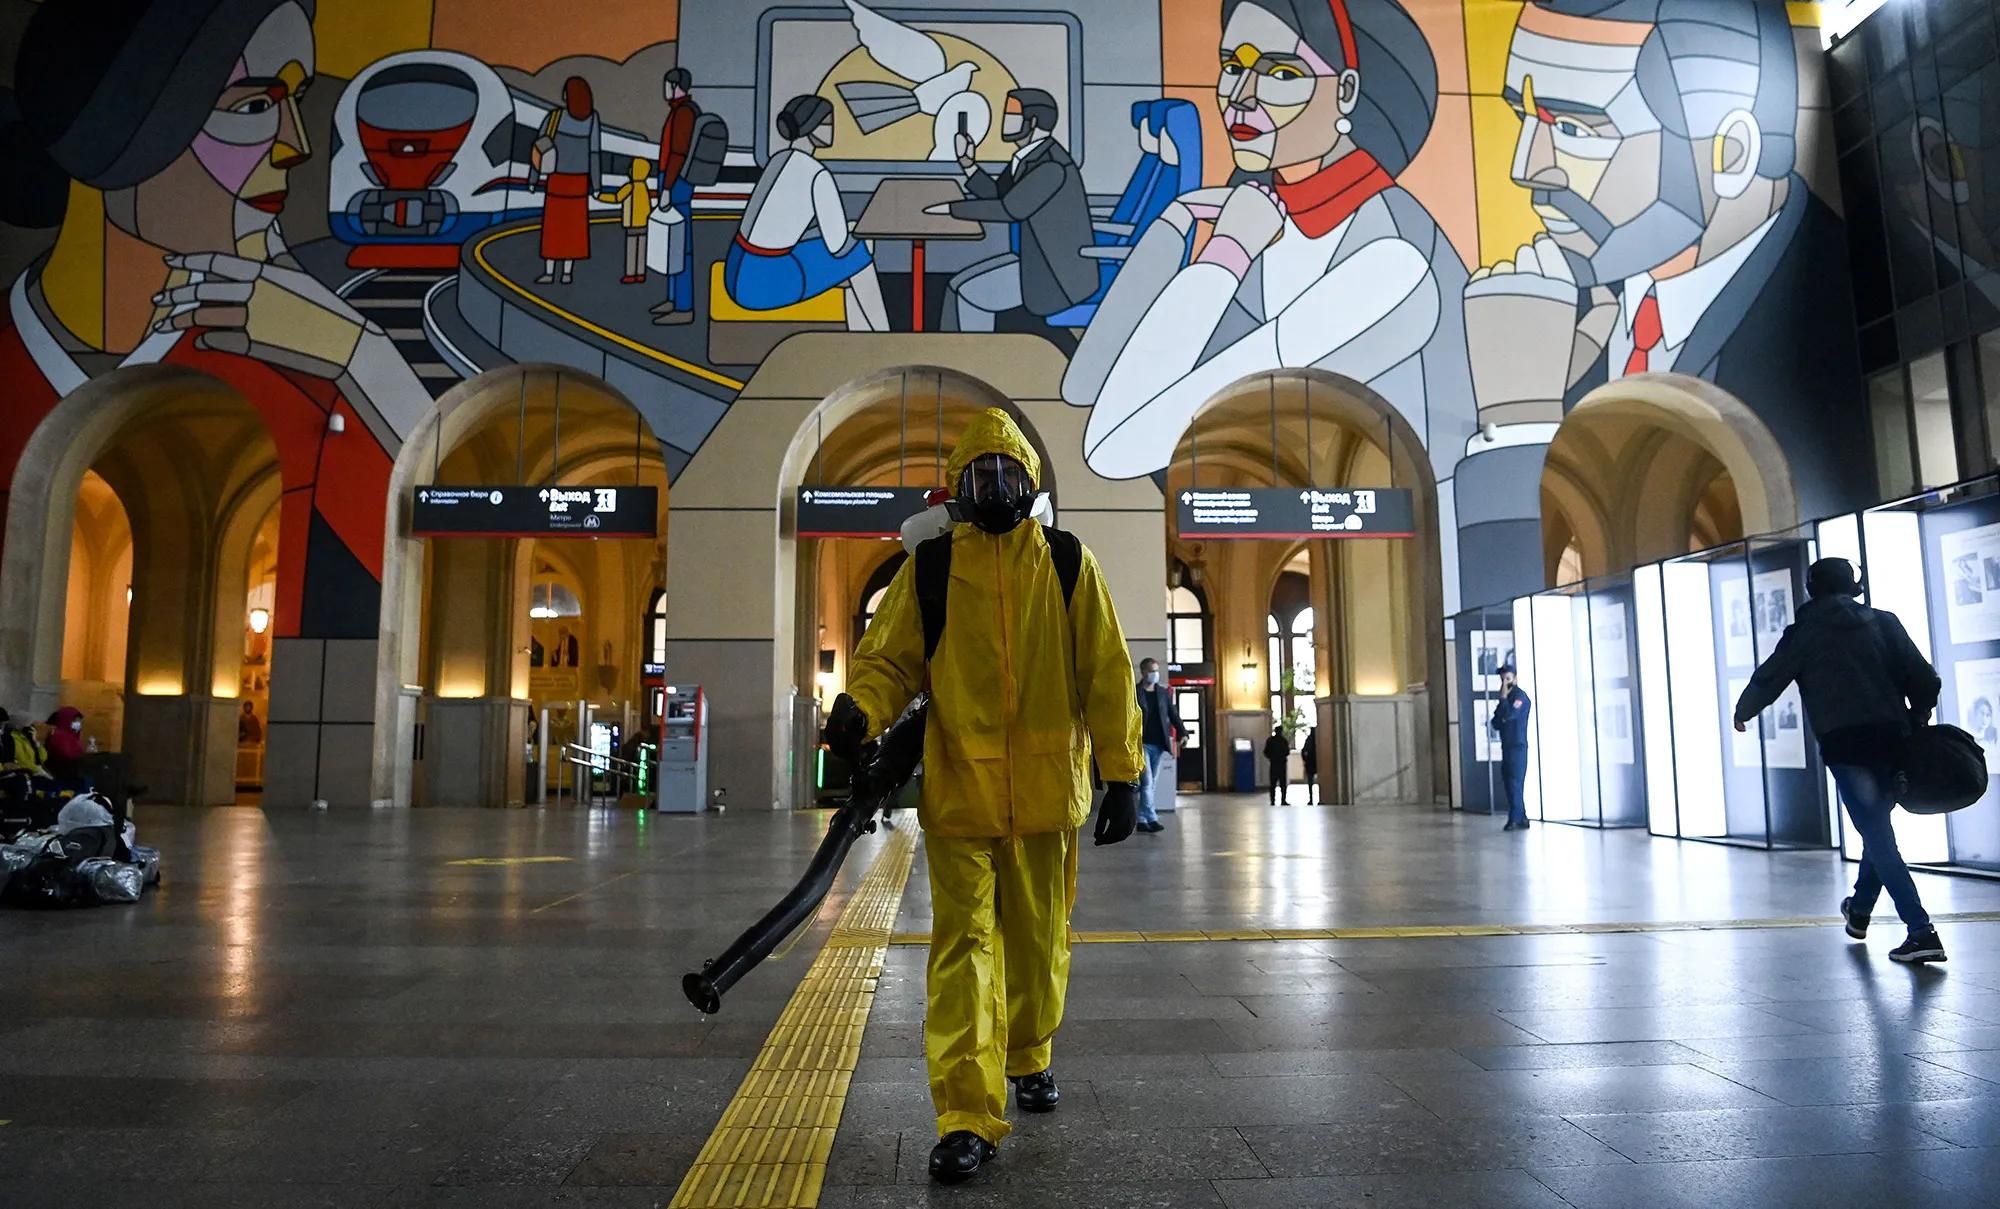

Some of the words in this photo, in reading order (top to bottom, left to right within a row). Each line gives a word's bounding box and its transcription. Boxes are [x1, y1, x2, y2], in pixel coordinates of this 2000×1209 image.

[430, 490, 469, 498] Справочное
[470, 490, 489, 499] бюро
[549, 488, 591, 503] Выход
